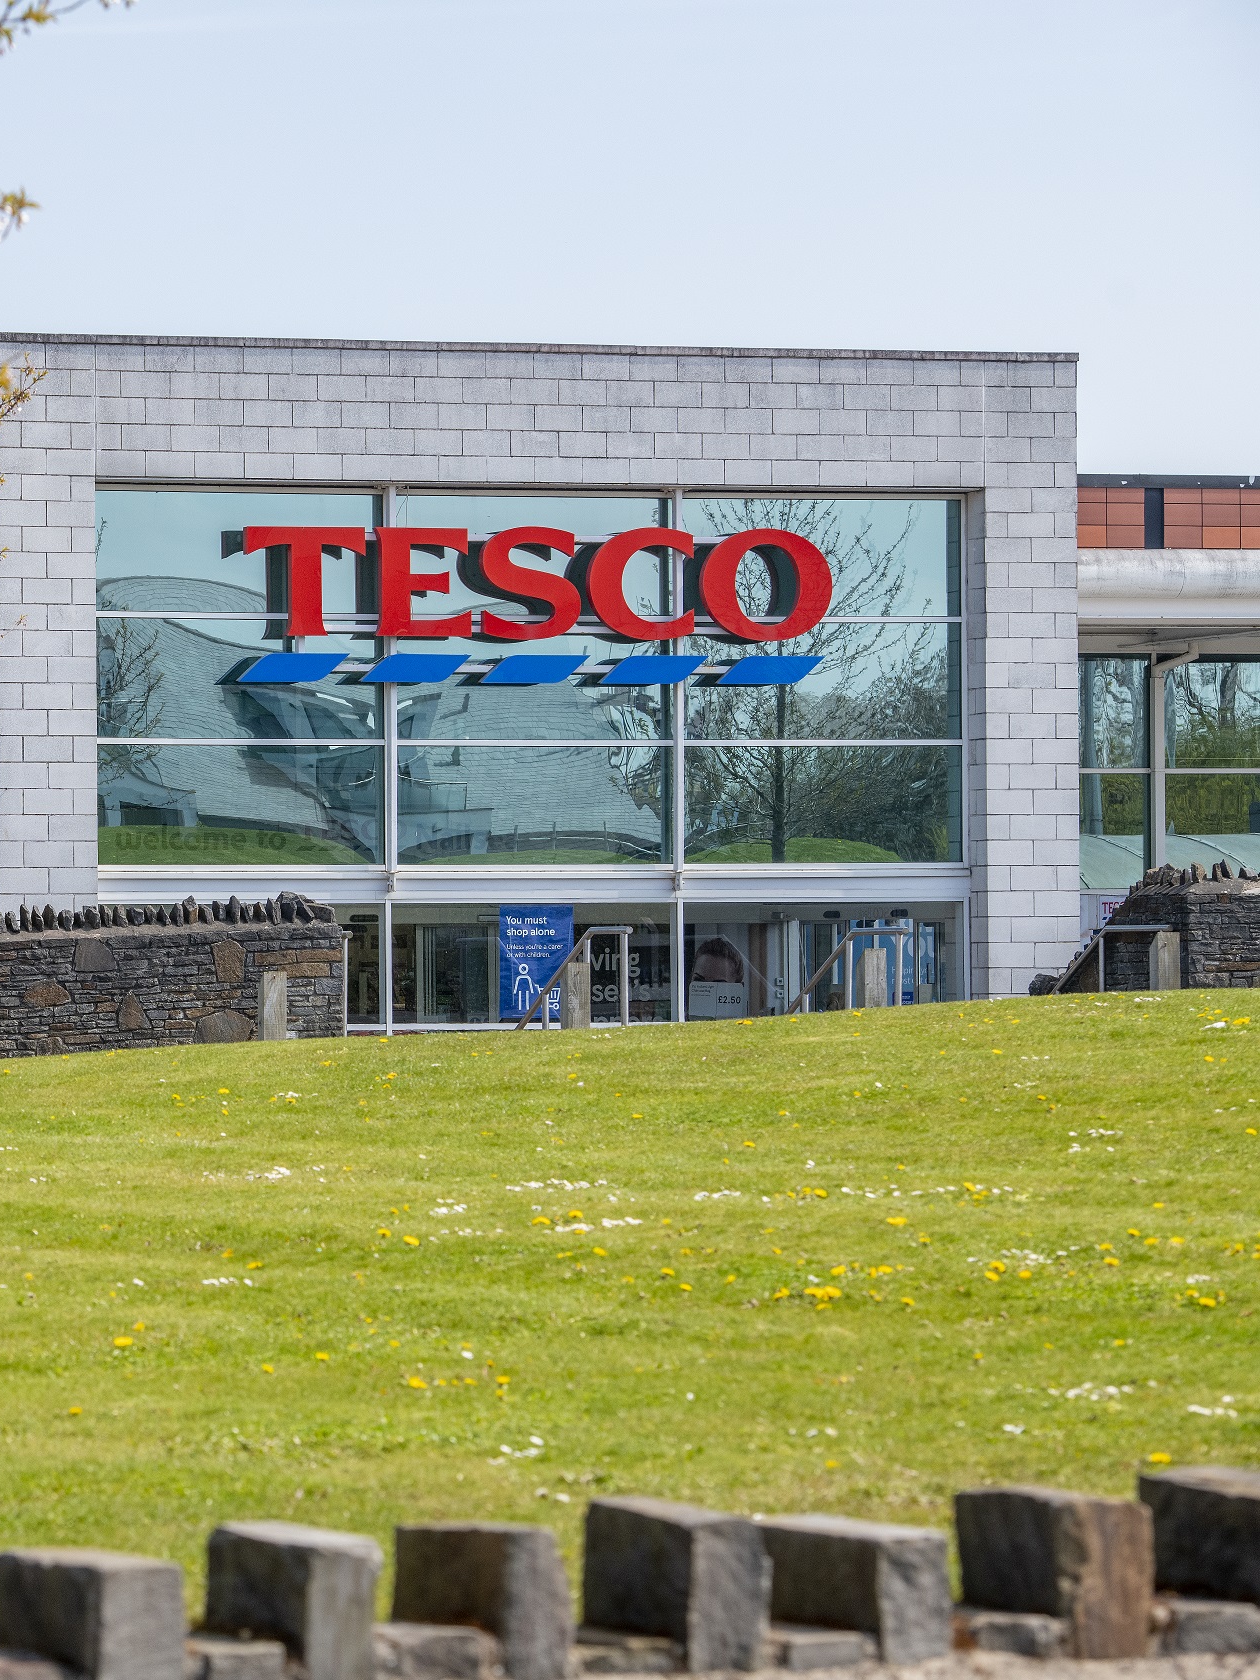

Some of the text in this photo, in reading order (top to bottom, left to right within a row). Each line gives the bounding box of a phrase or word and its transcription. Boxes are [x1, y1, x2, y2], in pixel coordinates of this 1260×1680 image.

[242, 526, 833, 642] TESCO
[114, 822, 247, 851] welcome
[256, 827, 286, 851] to
[506, 915, 548, 925] You must
[506, 928, 556, 938] shop alone
[525, 943, 543, 952] you're
[589, 947, 641, 978] ving
[718, 995, 742, 1005] £2.50
